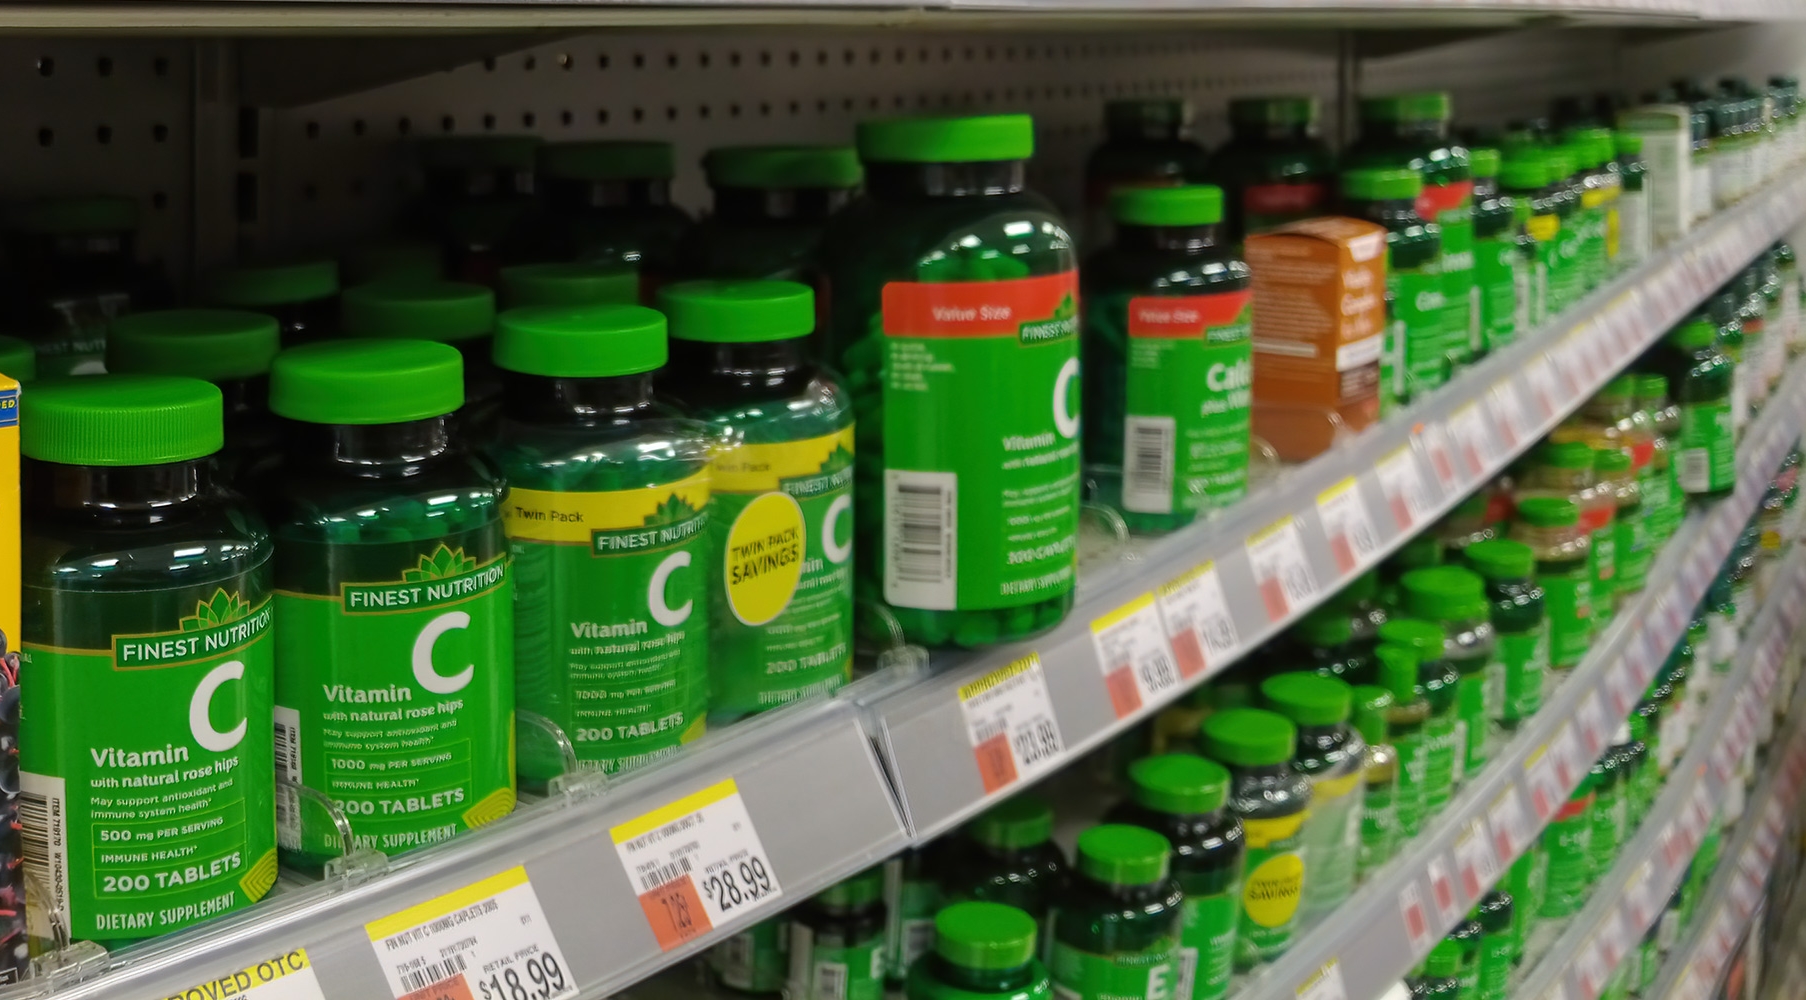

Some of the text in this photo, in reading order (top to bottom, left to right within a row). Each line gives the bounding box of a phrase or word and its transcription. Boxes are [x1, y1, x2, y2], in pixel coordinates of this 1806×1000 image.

[732, 526, 799, 561] TWIN PACK
[731, 544, 799, 586] SAVINGS
[649, 551, 693, 627] C
[123, 611, 271, 661] FINEST NUTRITION
[571, 619, 648, 638] Vitamin
[412, 611, 474, 694] C
[91, 661, 247, 768] Vitamin C
[323, 684, 411, 703] Vitamin
[91, 756, 238, 789] with natural rose hips
[103, 853, 241, 892] 200 TABLETS
[703, 852, 770, 912] $28.99
